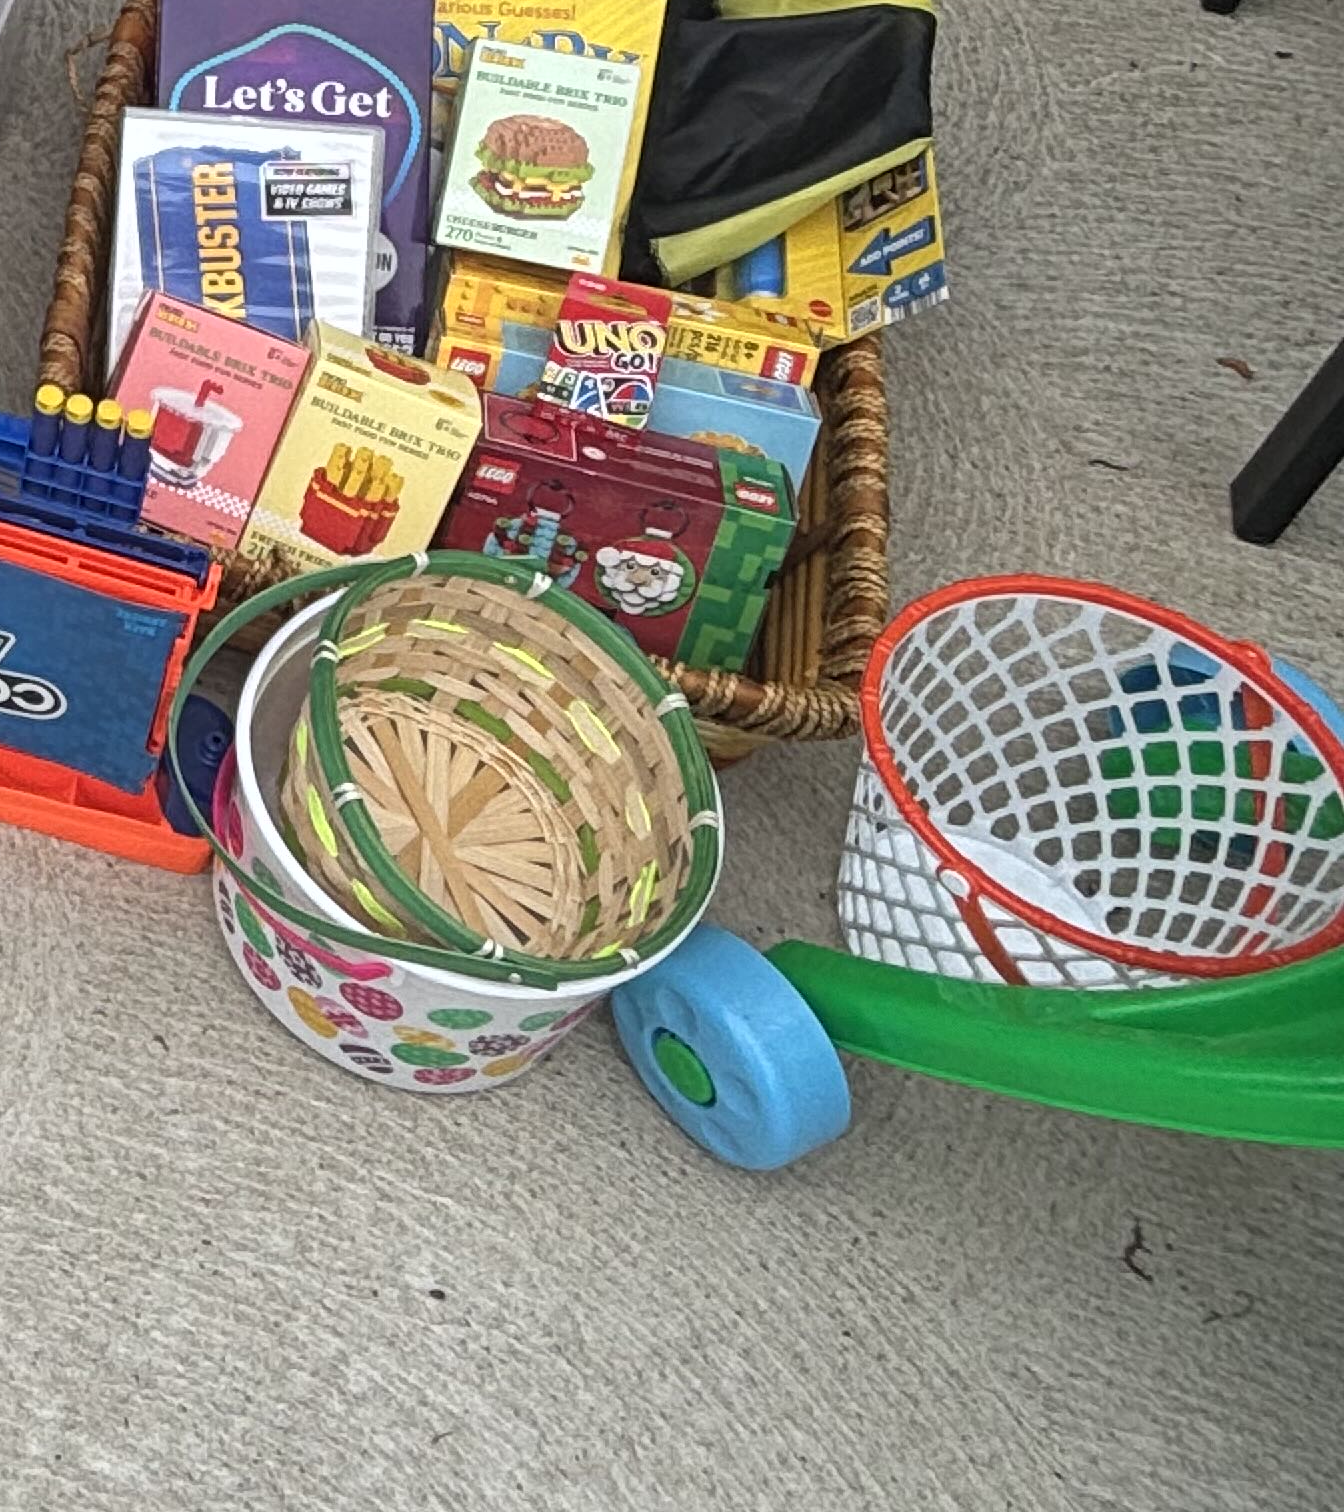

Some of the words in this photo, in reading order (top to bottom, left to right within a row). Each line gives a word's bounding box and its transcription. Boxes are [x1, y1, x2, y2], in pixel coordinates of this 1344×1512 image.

[498, 1, 577, 22] Guesses!
[203, 75, 306, 113] Let's
[311, 80, 392, 118] Get
[191, 162, 246, 319] KBUSTER
[444, 225, 474, 243] 270
[555, 320, 667, 356] UNO
[449, 357, 486, 376] LEGO
[612, 352, 659, 373] GO!
[310, 395, 387, 433] BUILDABLE
[388, 425, 424, 449] BRIX
[427, 439, 462, 462] TRIO
[476, 465, 517, 485] LEGO
